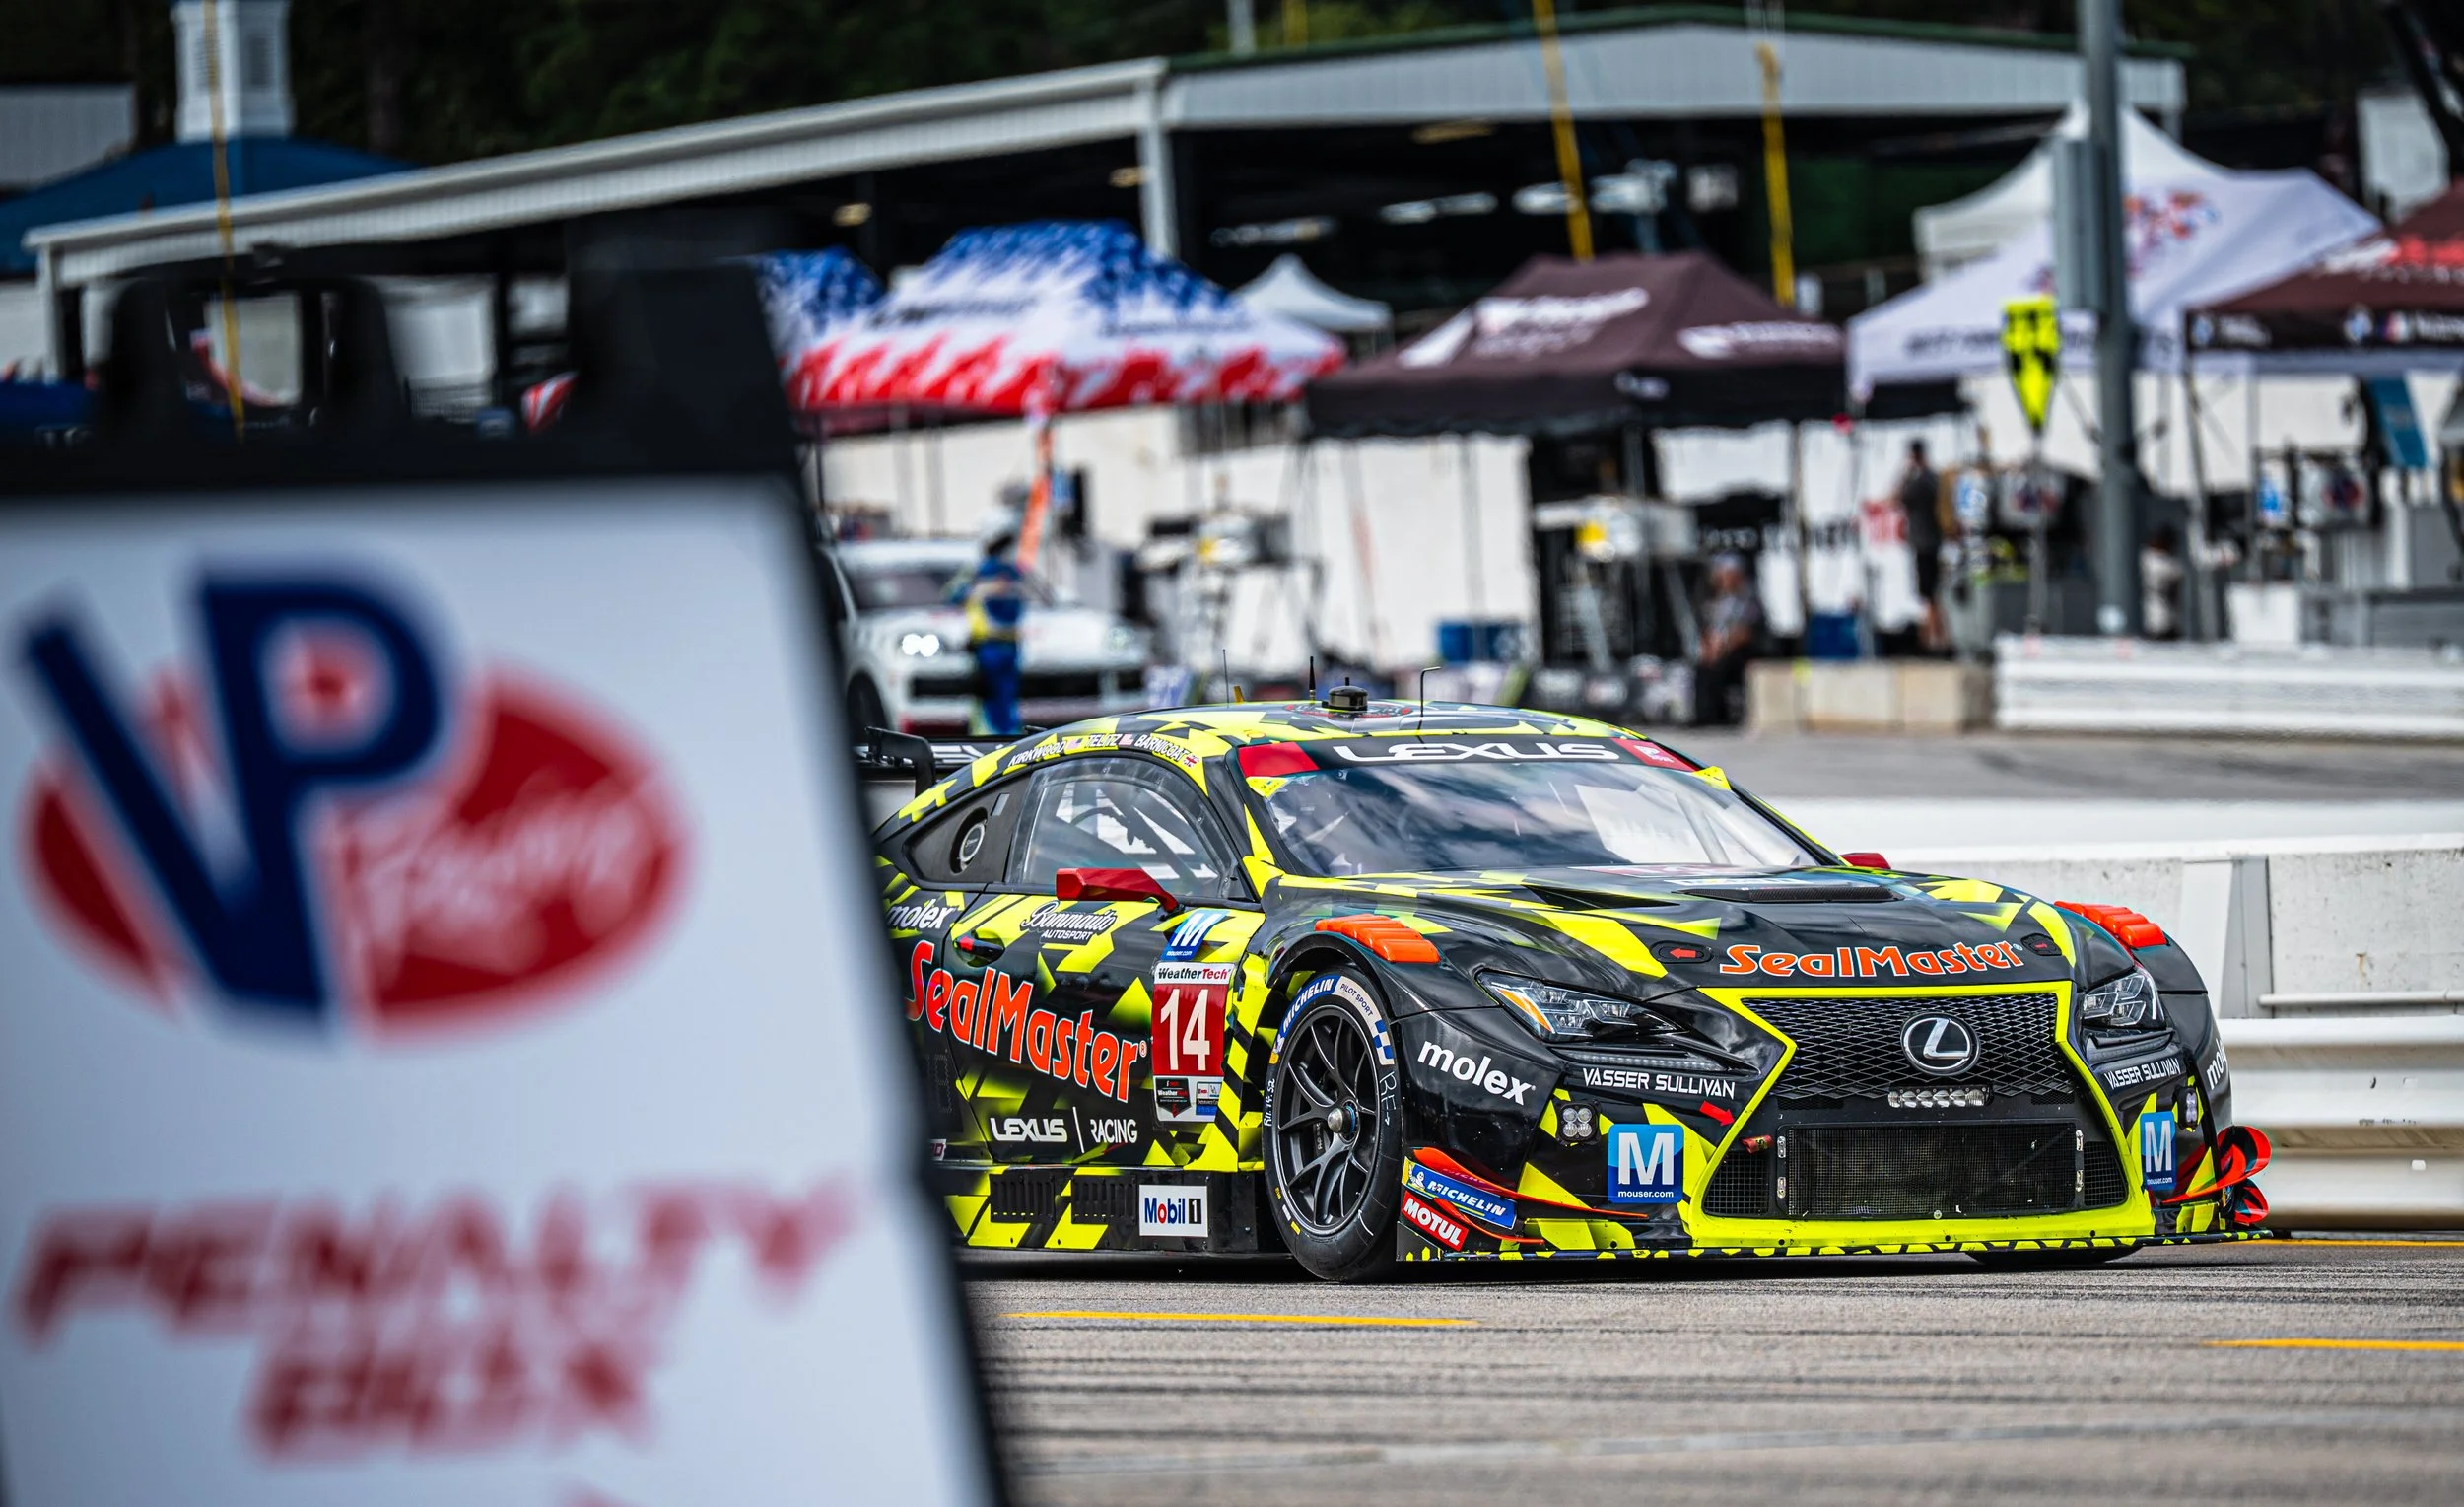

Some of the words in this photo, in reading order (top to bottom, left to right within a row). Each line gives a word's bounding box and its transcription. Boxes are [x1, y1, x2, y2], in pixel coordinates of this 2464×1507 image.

[1008, 740, 1067, 767] KIRKWOOD
[1084, 733, 1122, 748] TELITZ
[1134, 734, 1191, 762] BARNICOAT
[1333, 742, 1619, 762] LEXUS
[16, 566, 449, 1021] VP
[887, 899, 953, 929] molex
[1171, 913, 1222, 947] M
[1041, 929, 1094, 940] AUTOSPORT
[1158, 967, 1229, 980] WeatherTech
[1719, 940, 2024, 978] SealMaster
[1282, 978, 1335, 1034] MICHELIN
[1340, 983, 1357, 996] PILOT
[1356, 993, 1373, 1017] SPORT
[904, 939, 1139, 1103] SealMaster
[1160, 988, 1210, 1071] 14
[1417, 1041, 1533, 1106] molex
[1583, 1067, 1650, 1090] VASSER
[1655, 1074, 1736, 1100] SULLIVAN
[2104, 1068, 2142, 1090] VASSER
[2141, 1057, 2180, 1084] SULLIVAN
[990, 1118, 1068, 1142] LEXUS
[1091, 1118, 1138, 1144] RACING
[2144, 1120, 2172, 1174] M
[1618, 1132, 1675, 1186] M
[1144, 1197, 1186, 1225] Mobil
[1427, 1180, 1507, 1217] MICHELIN
[1618, 1190, 1675, 1199] mouser.com
[1403, 1197, 1462, 1247] MOTUL
[14, 1181, 857, 1344] PENALTY
